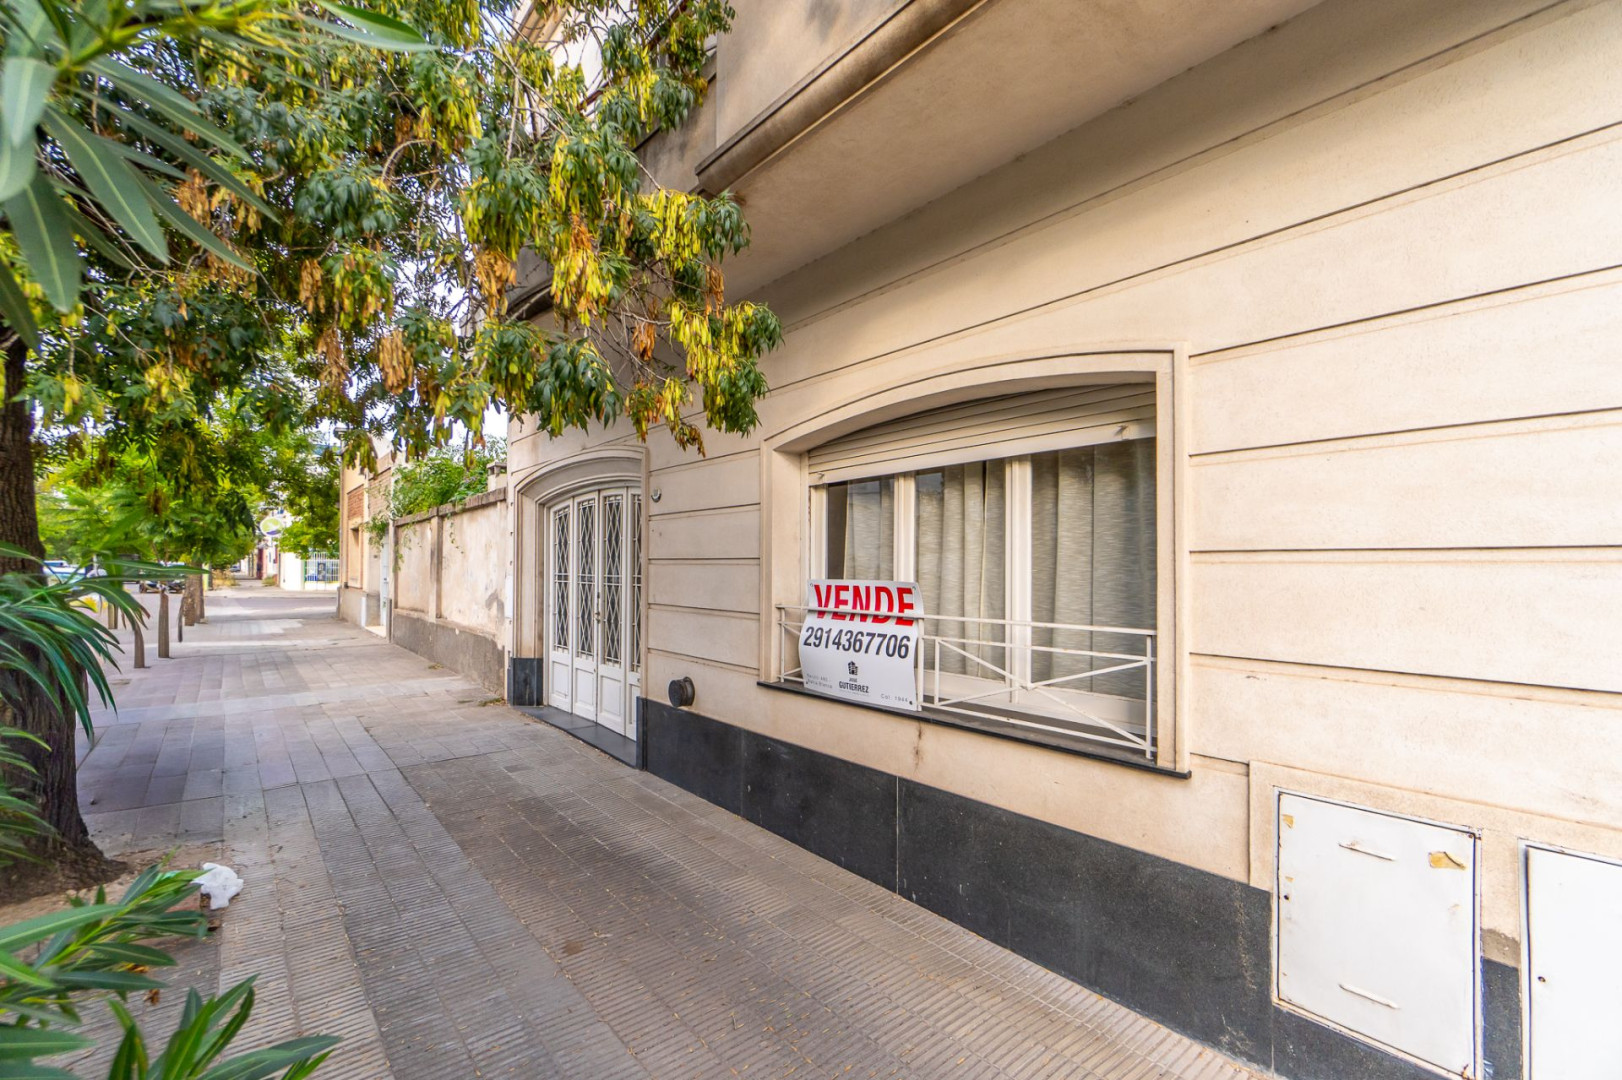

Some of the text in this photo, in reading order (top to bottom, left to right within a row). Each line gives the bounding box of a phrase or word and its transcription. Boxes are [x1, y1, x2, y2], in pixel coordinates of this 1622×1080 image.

[813, 584, 915, 626] VENDE
[803, 626, 911, 659] 2914367706
[838, 680, 869, 693] GUTIERREZ
